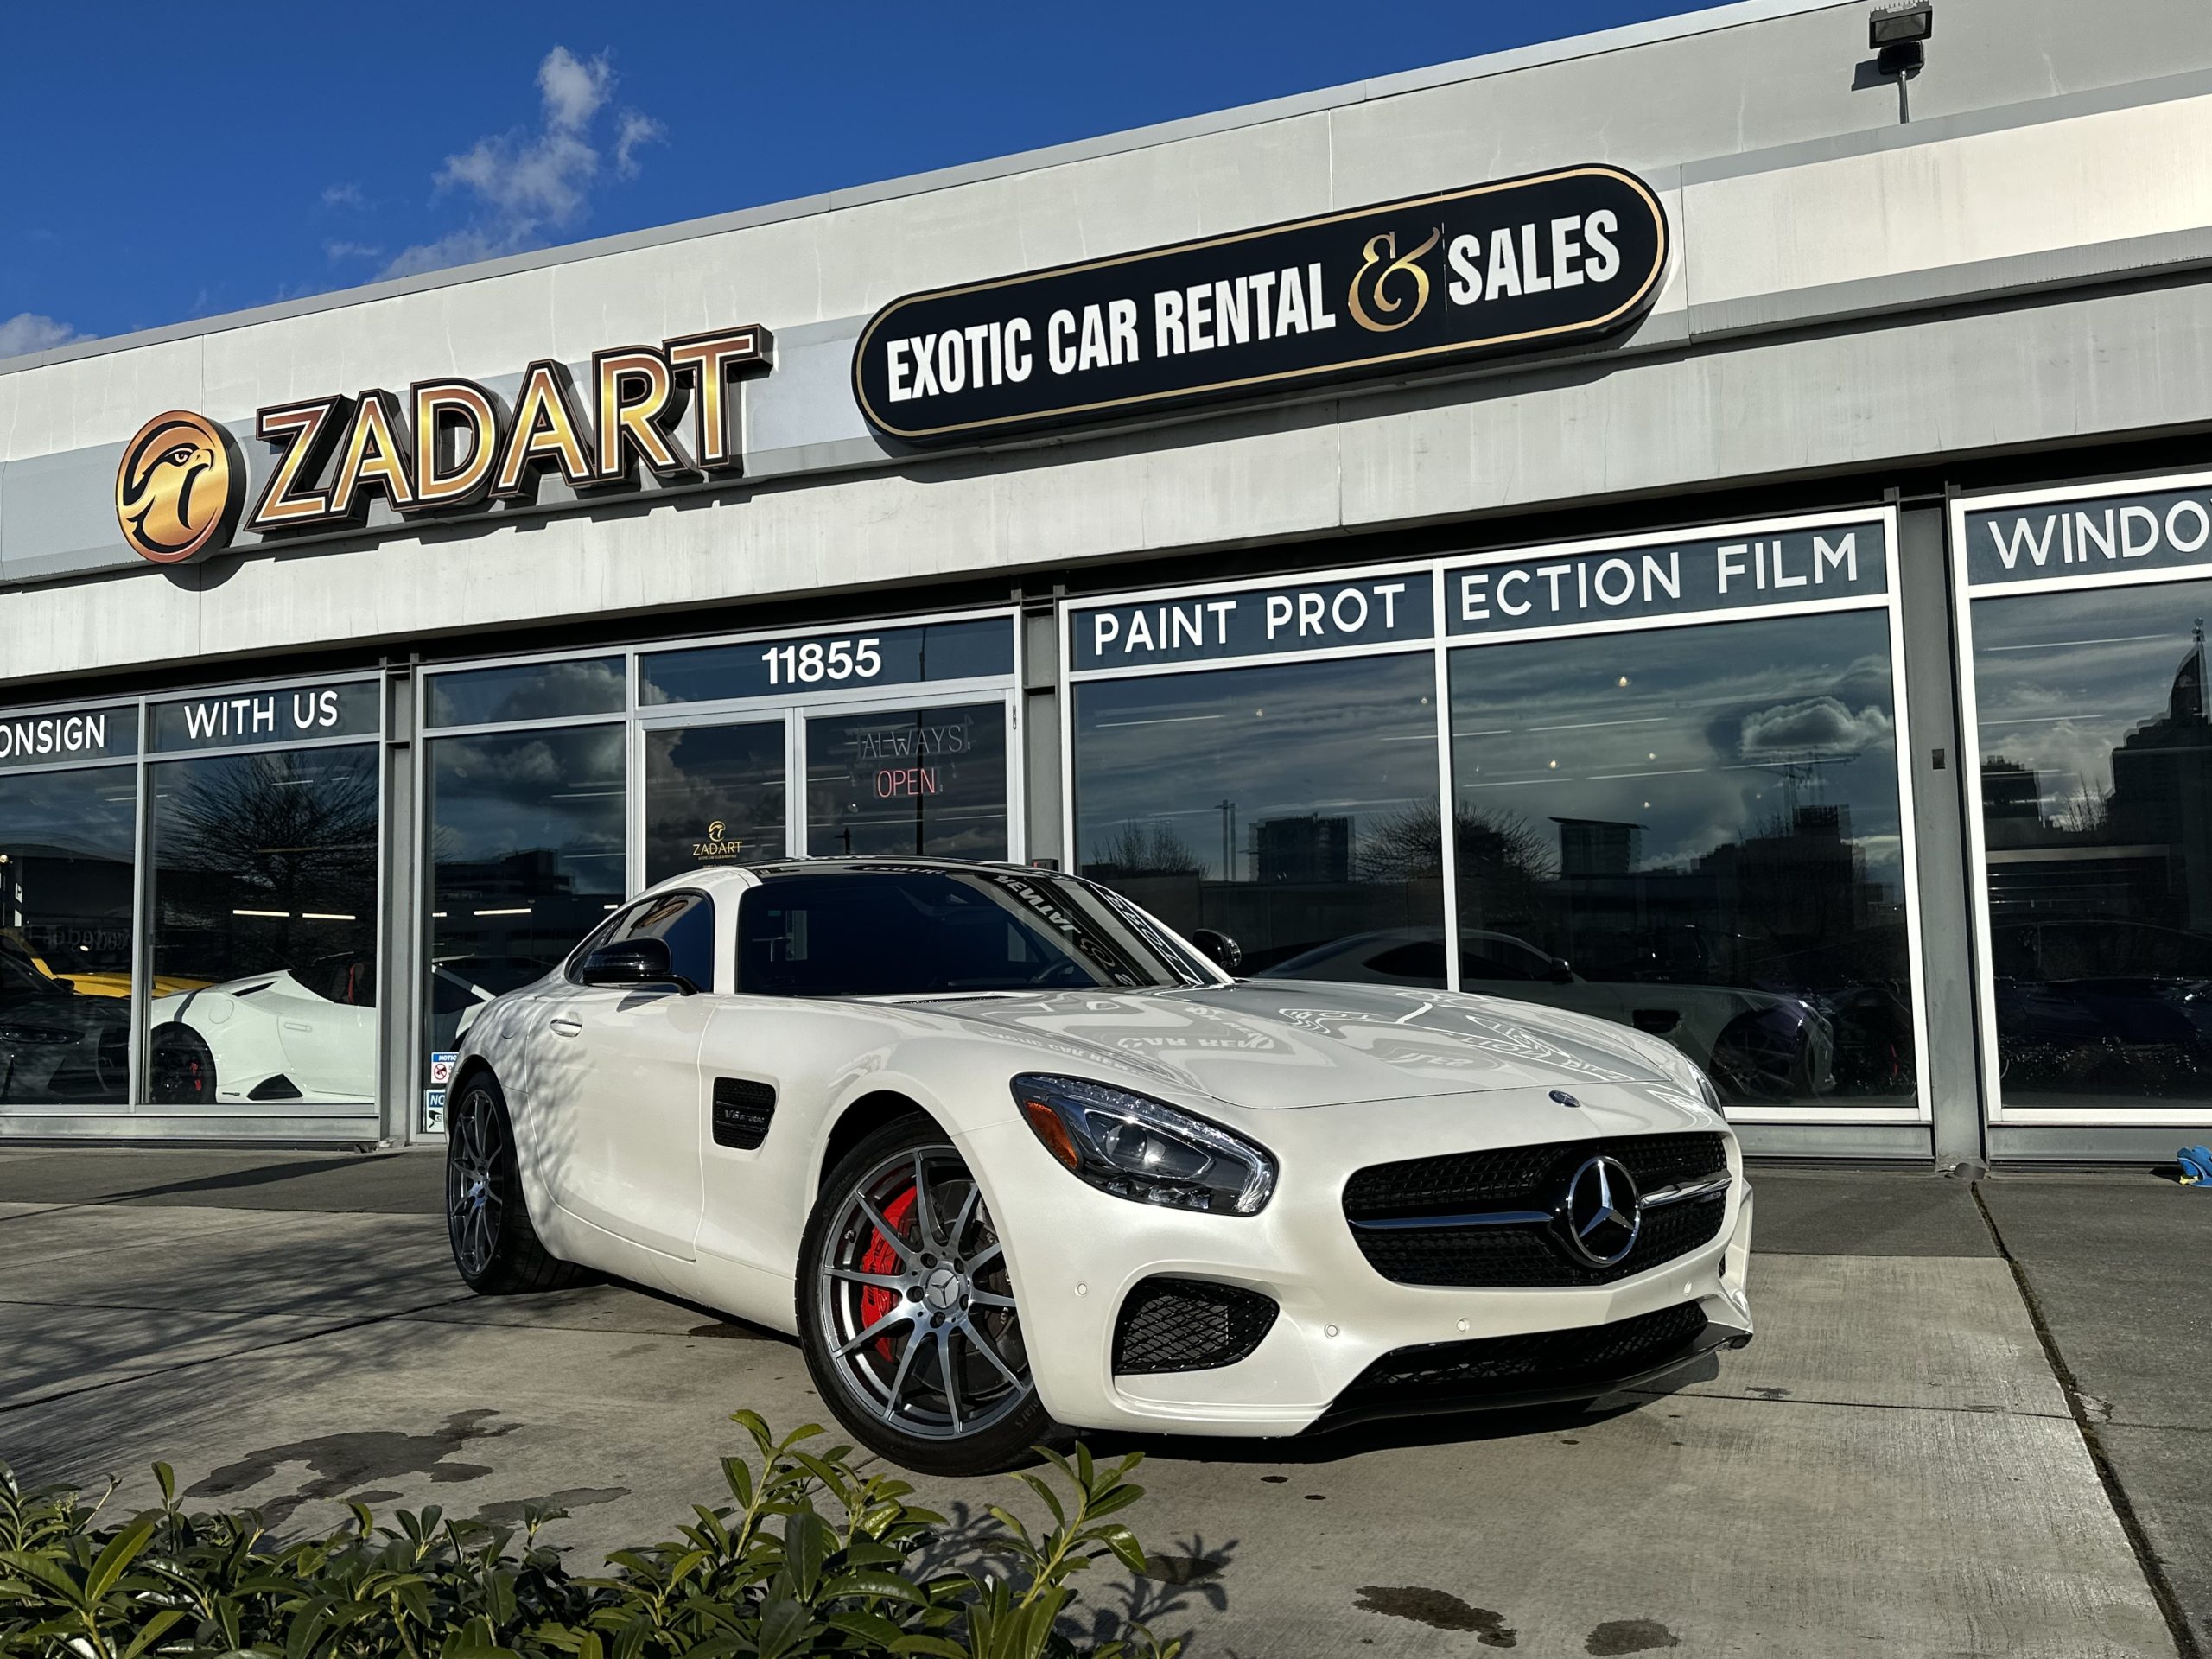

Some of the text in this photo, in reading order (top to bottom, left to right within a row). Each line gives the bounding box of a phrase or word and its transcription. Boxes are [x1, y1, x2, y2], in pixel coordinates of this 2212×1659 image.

[887, 208, 1621, 403] EXOTIC CAR RENTAL & SALES
[244, 323, 774, 531] ZADART
[1988, 499, 2212, 569] WINDO
[1095, 532, 1857, 656] PAINT PROT ECTION FILM
[761, 638, 881, 684] 11855
[184, 696, 275, 740] WITH
[293, 690, 339, 729] US
[863, 725, 963, 759] ALWAYS
[877, 767, 936, 798] OPEN
[692, 841, 743, 856] ZADART
